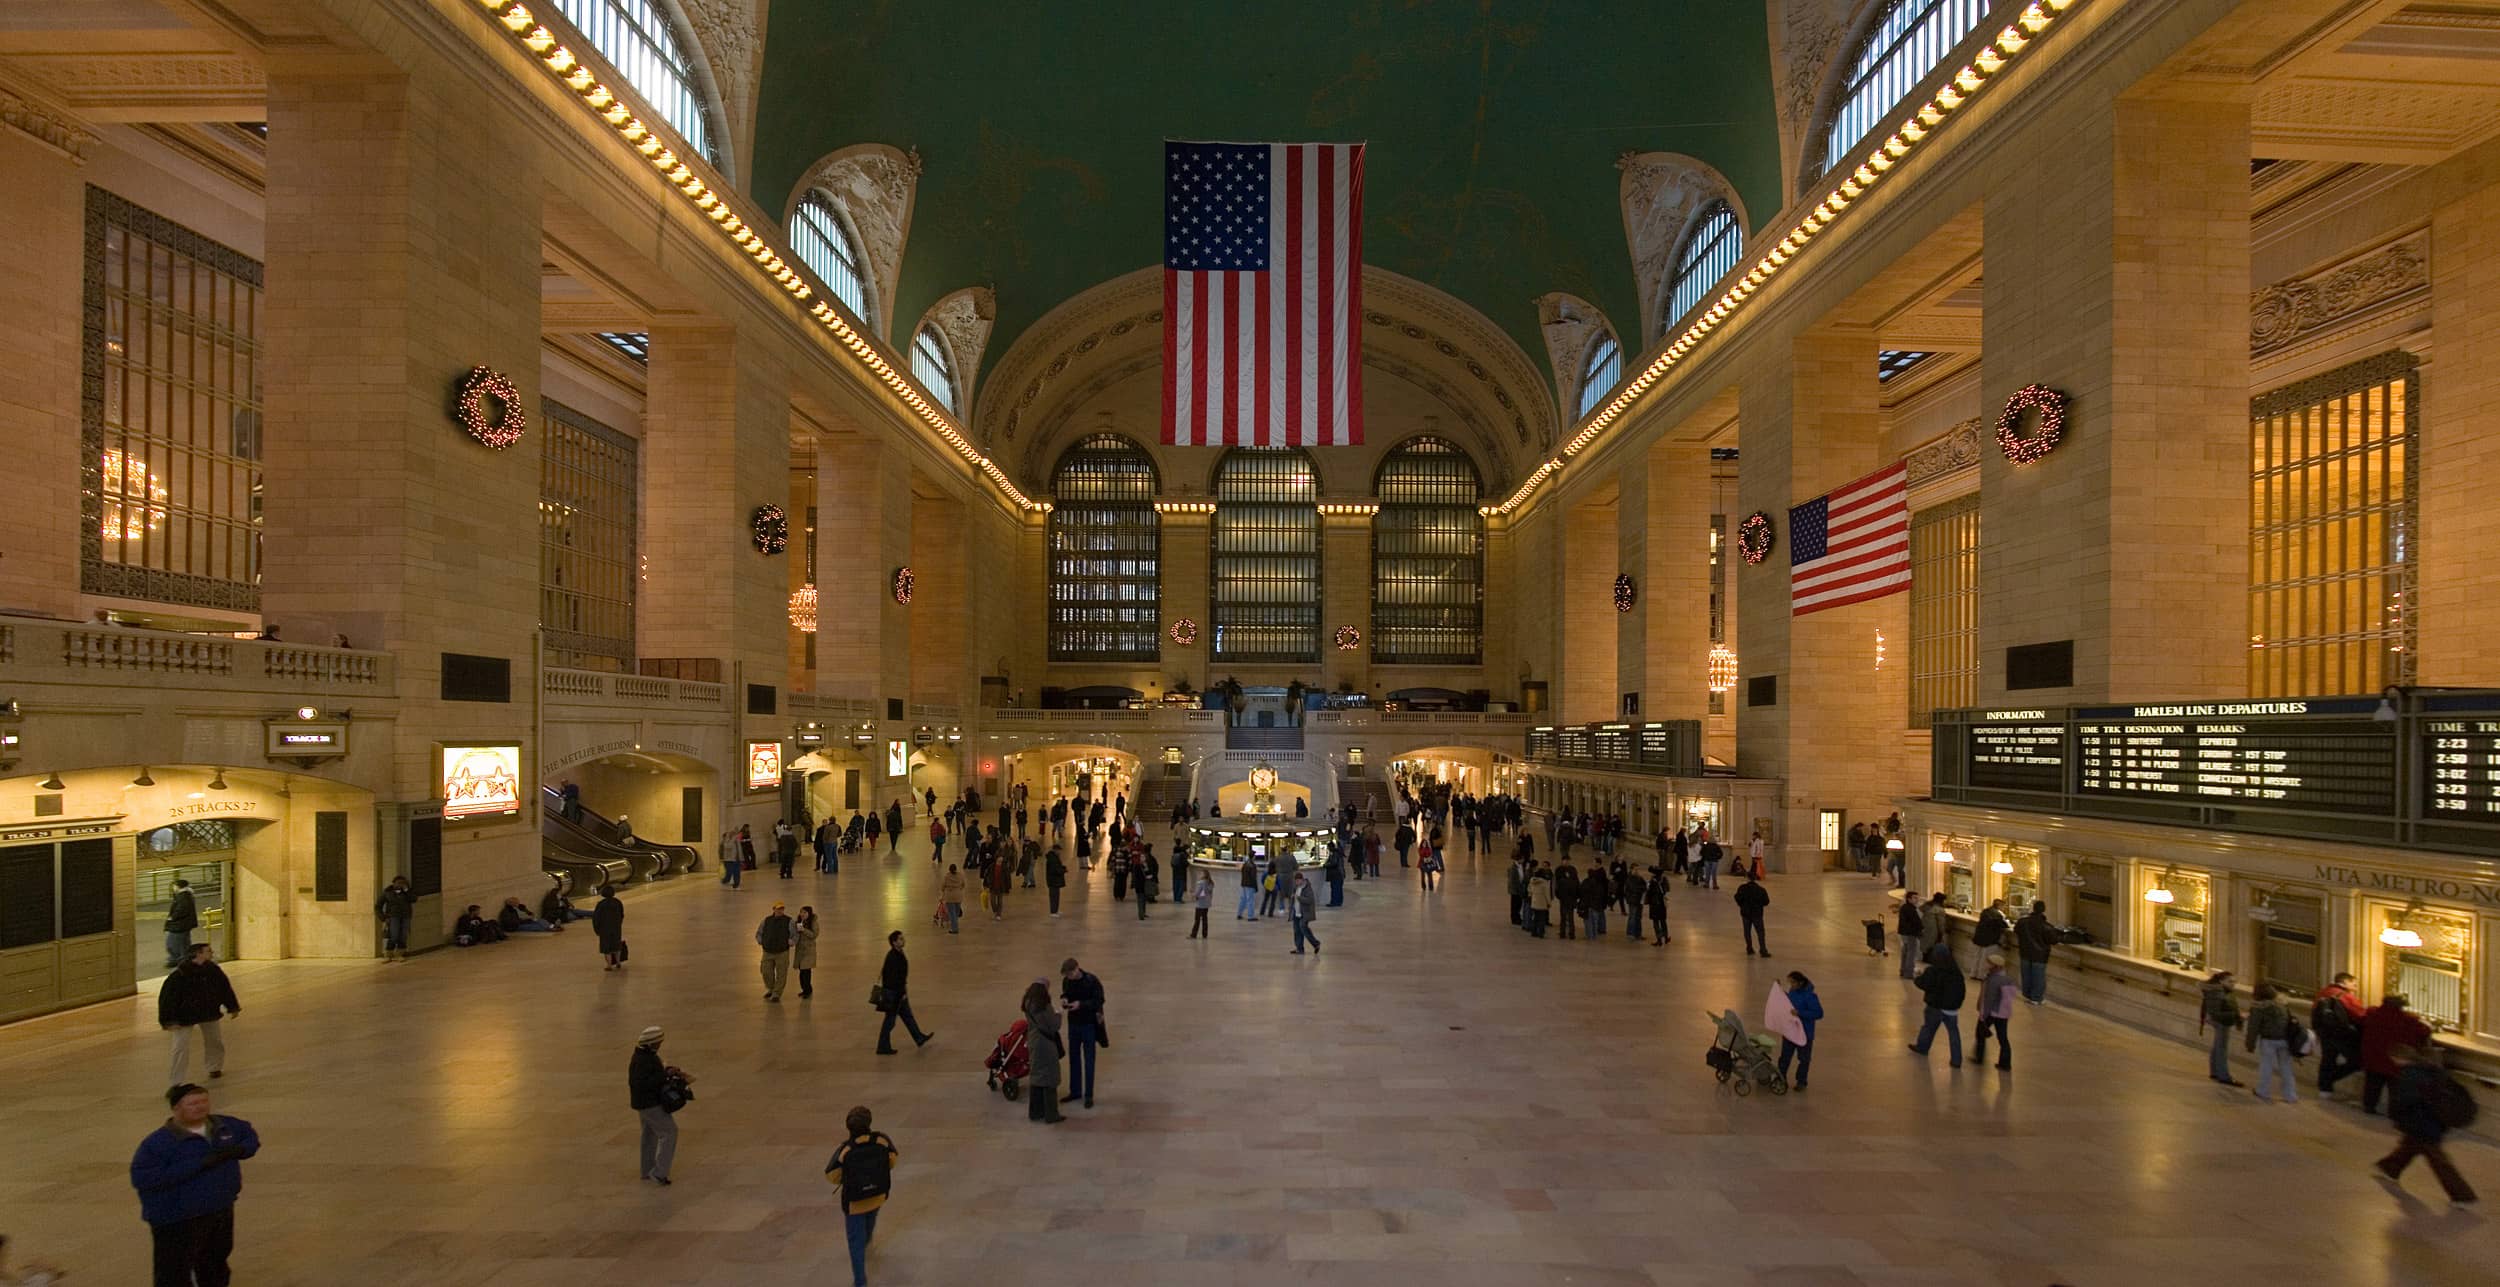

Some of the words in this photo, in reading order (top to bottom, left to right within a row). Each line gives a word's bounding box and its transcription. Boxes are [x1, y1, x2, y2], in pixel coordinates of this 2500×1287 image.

[2134, 706, 2184, 717] HARLEM
[2186, 705, 2216, 715] LINE
[2218, 702, 2307, 715] DEPARTURES
[1986, 710, 2046, 720] INFORMATION
[2124, 725, 2184, 733] DESTINATION
[2196, 725, 2246, 733] REMARKS
[2427, 722, 2467, 732] TIME
[2475, 722, 2500, 732] TR
[2437, 739, 2467, 749] 2:23
[2263, 751, 2287, 760] STOP
[2436, 754, 2467, 764] 2:50
[2263, 764, 2287, 773] STOP
[2263, 789, 2287, 799] STOP
[2436, 784, 2467, 795] 3:23
[187, 801, 240, 814] TRACKS
[243, 802, 257, 811] 27
[2315, 865, 2361, 885] MTA
[2371, 871, 2500, 904] METRO-N
